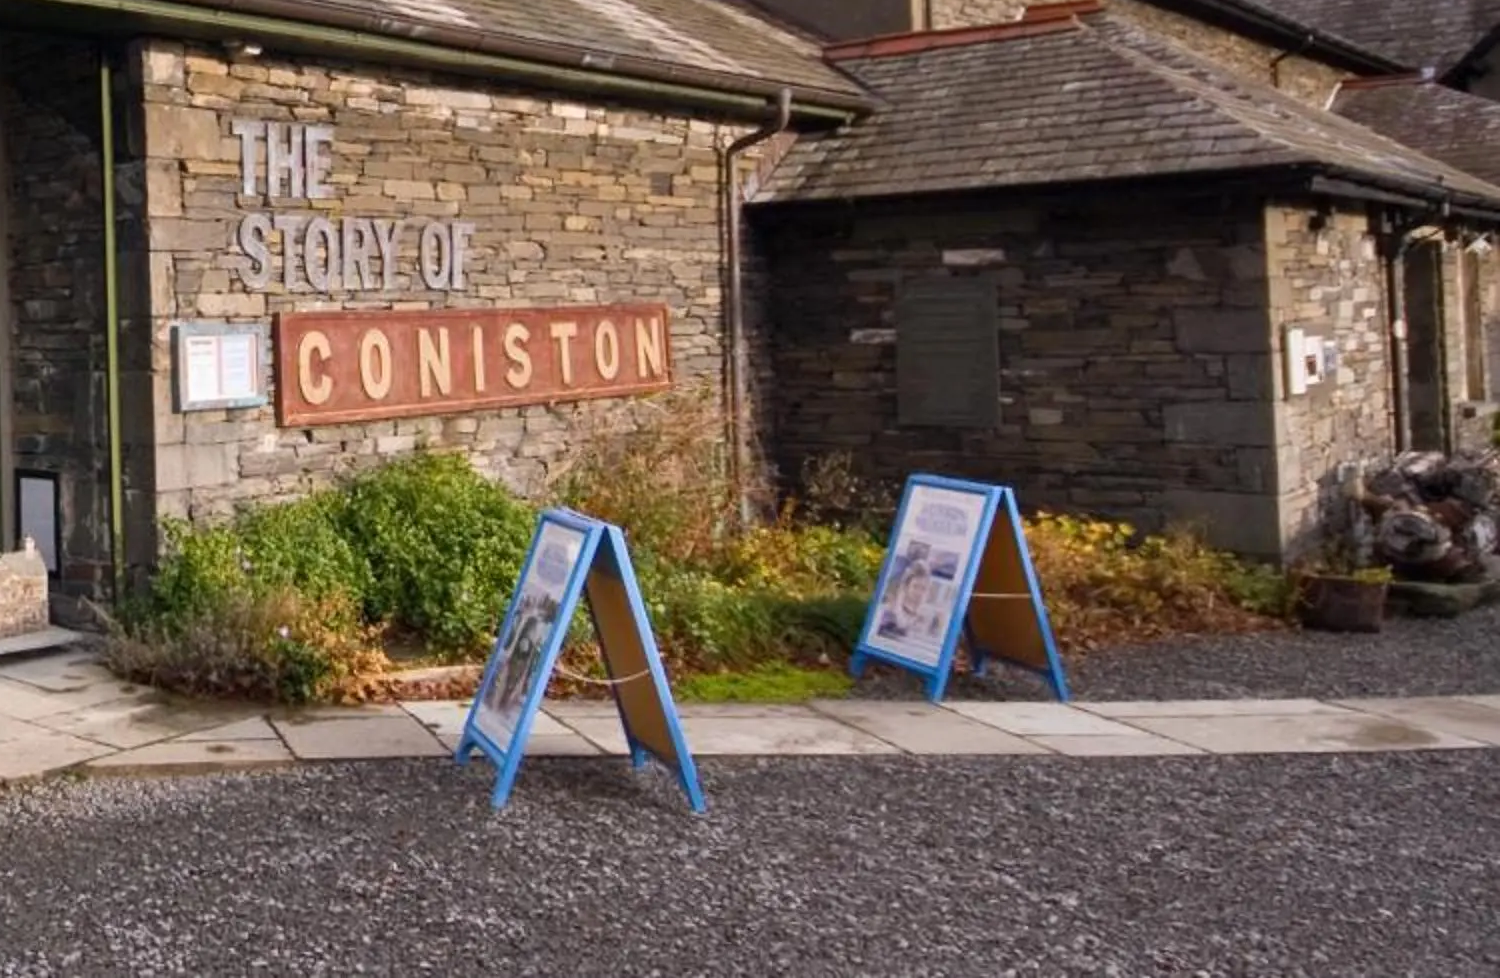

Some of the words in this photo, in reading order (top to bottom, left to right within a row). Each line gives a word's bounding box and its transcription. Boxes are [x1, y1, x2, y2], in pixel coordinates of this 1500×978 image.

[232, 121, 335, 199] THE
[236, 213, 399, 291] STORY
[420, 222, 475, 290] OF
[298, 318, 663, 405] CONISTON
